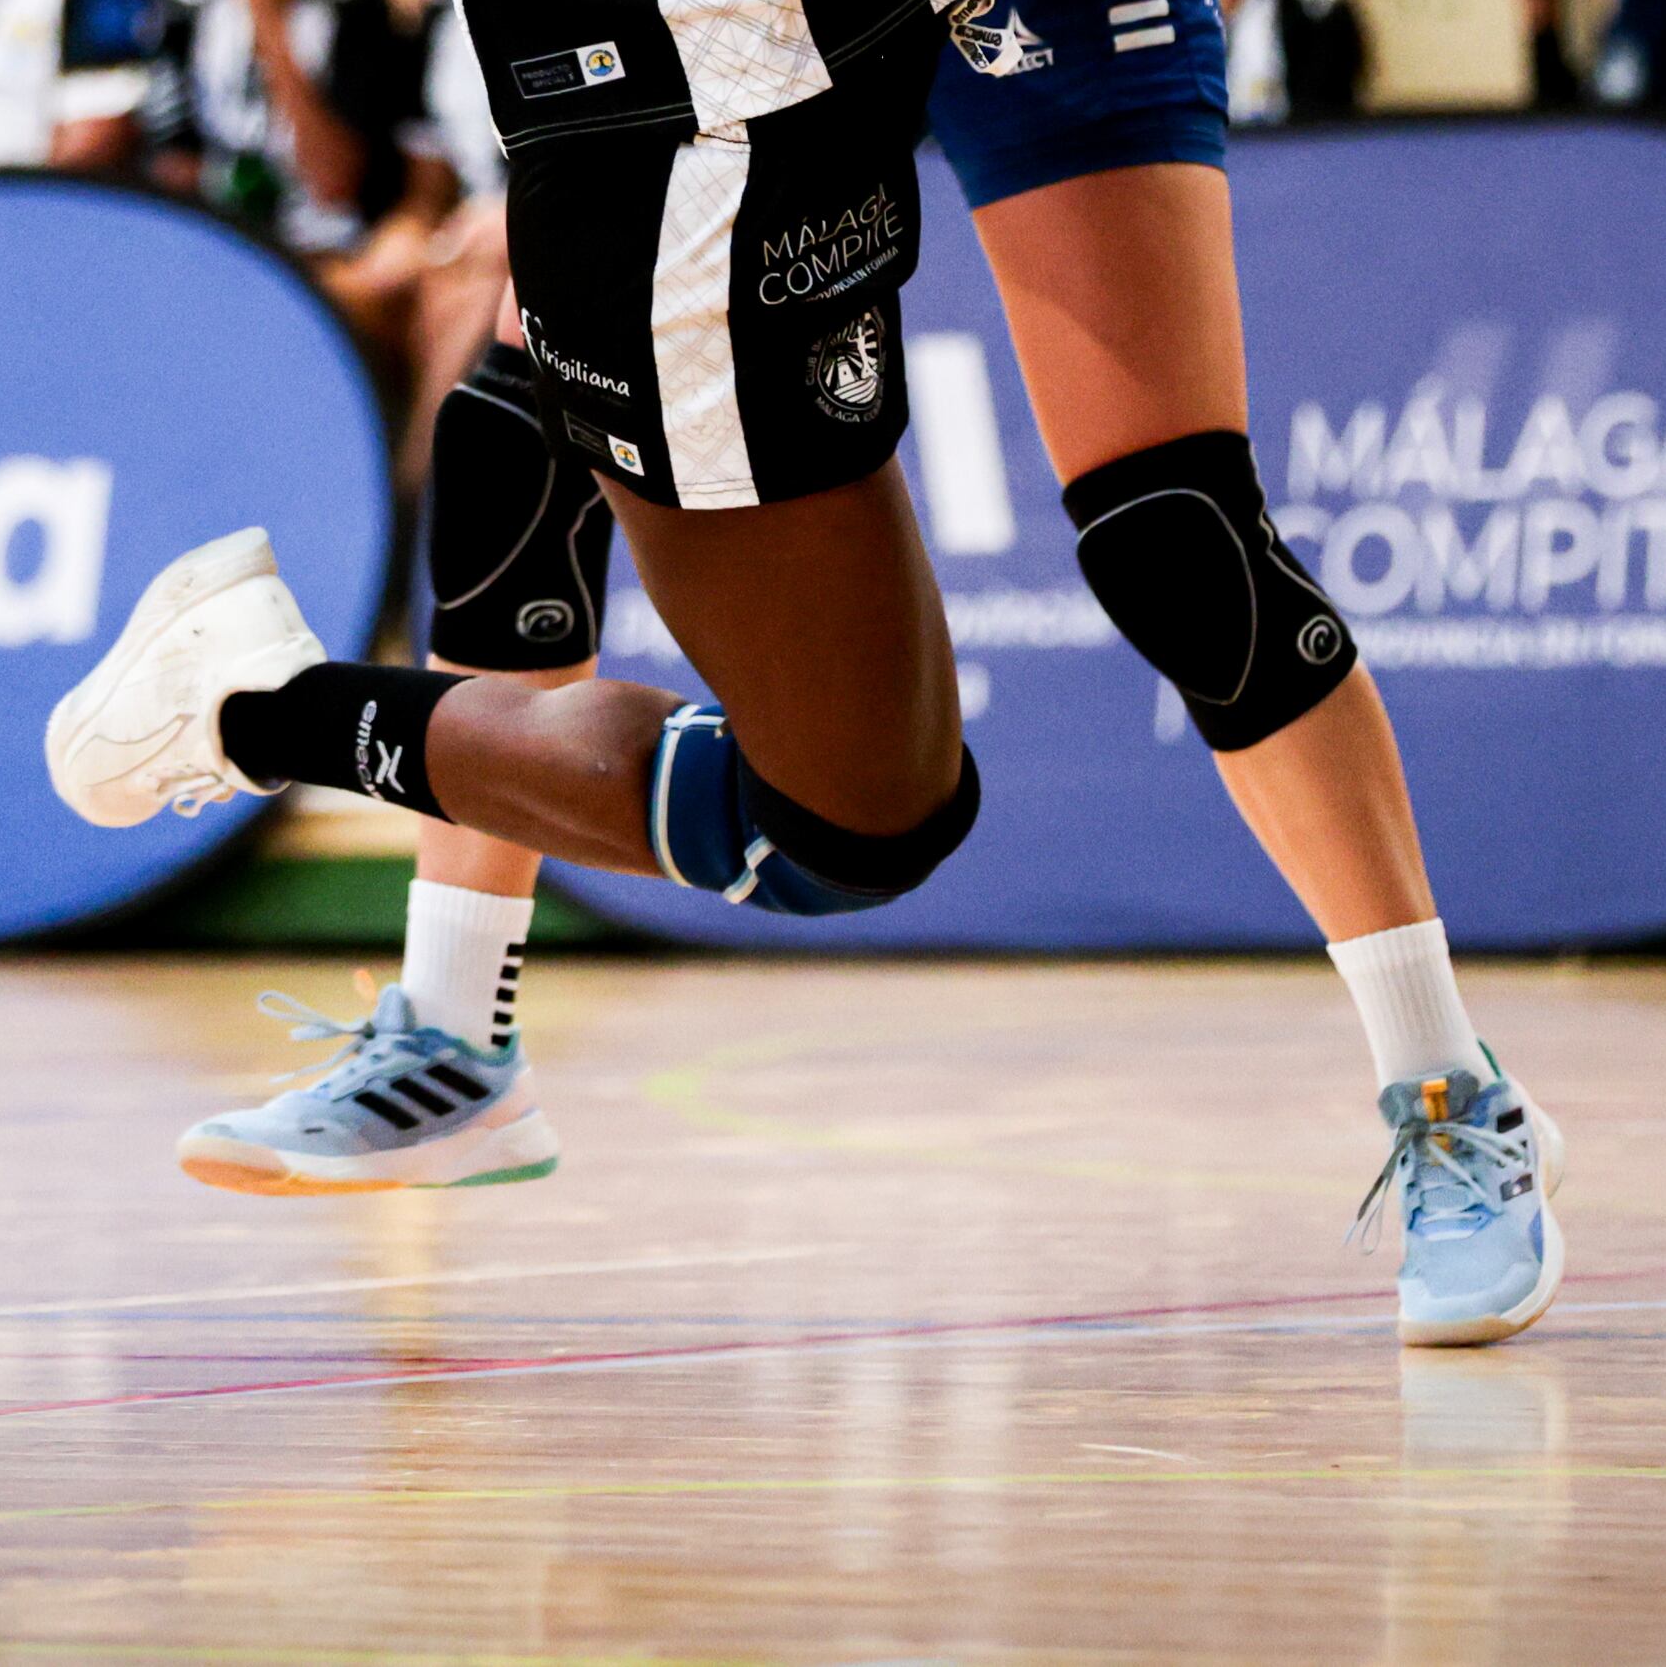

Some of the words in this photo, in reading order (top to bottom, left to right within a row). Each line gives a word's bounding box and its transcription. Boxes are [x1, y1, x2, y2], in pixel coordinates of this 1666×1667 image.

[759, 201, 903, 305] COMPITE
[763, 183, 886, 267] MÁLAGA
[540, 339, 631, 397] frigiliana
